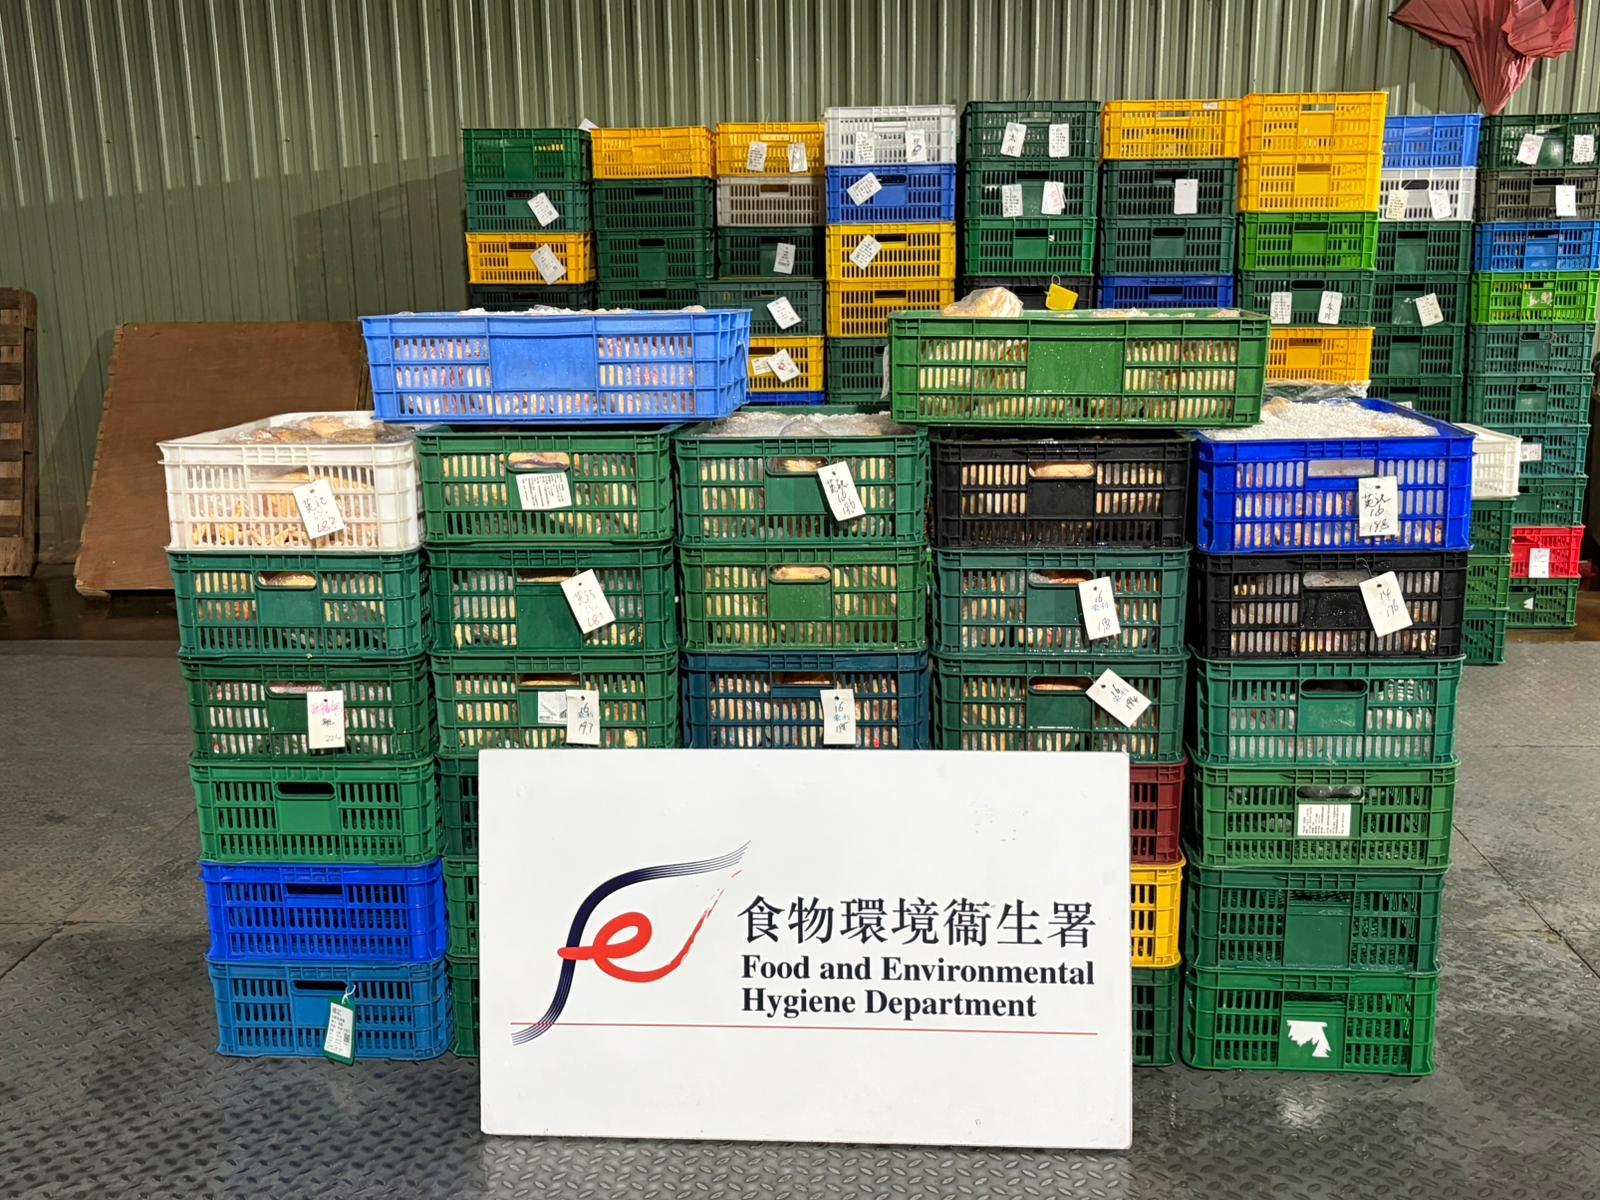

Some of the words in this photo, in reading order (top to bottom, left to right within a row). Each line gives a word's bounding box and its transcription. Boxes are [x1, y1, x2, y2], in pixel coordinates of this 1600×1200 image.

[834, 701, 844, 713] 16
[741, 955, 810, 980] Food
[819, 956, 872, 981] and
[881, 957, 1095, 985] Environmental
[741, 988, 857, 1018] Hygiene
[864, 989, 1038, 1020] Department
